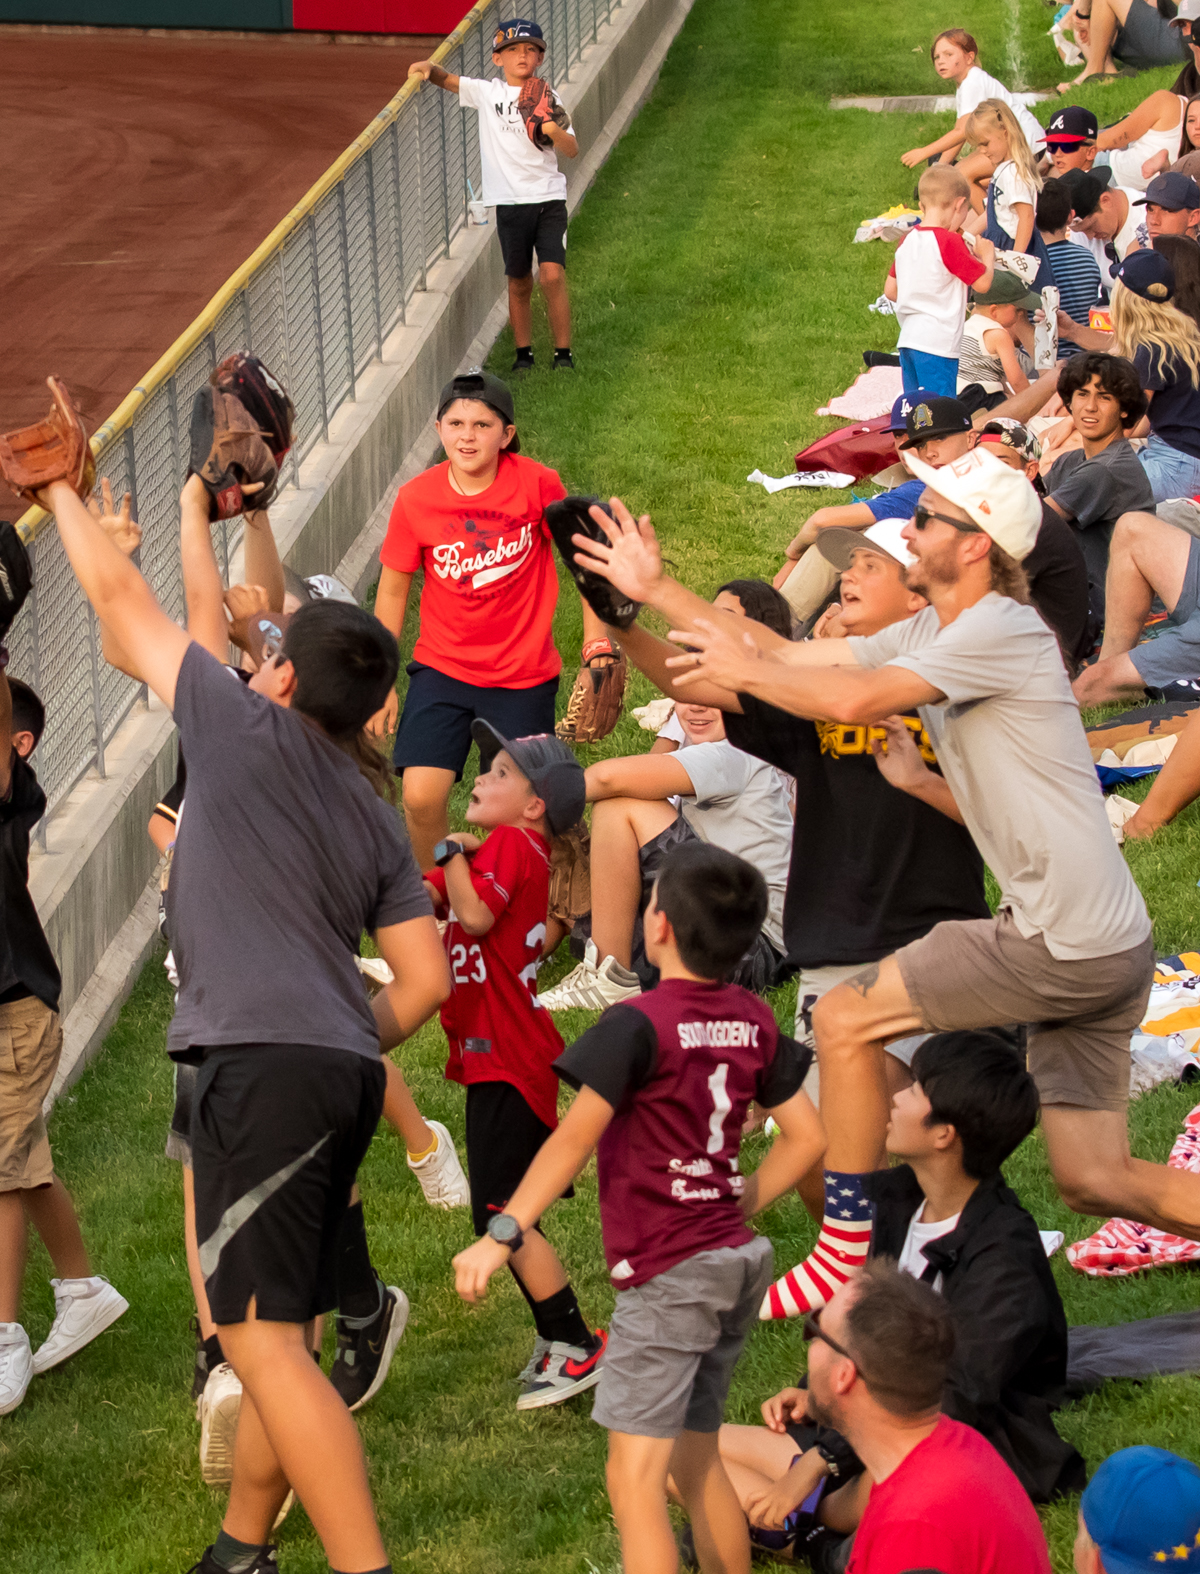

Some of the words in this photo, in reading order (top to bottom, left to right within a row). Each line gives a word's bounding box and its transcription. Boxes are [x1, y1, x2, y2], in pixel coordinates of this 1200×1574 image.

[1050, 114, 1065, 130] A
[900, 398, 913, 417] LA
[451, 943, 487, 984] 23
[706, 1063, 733, 1155] 1
